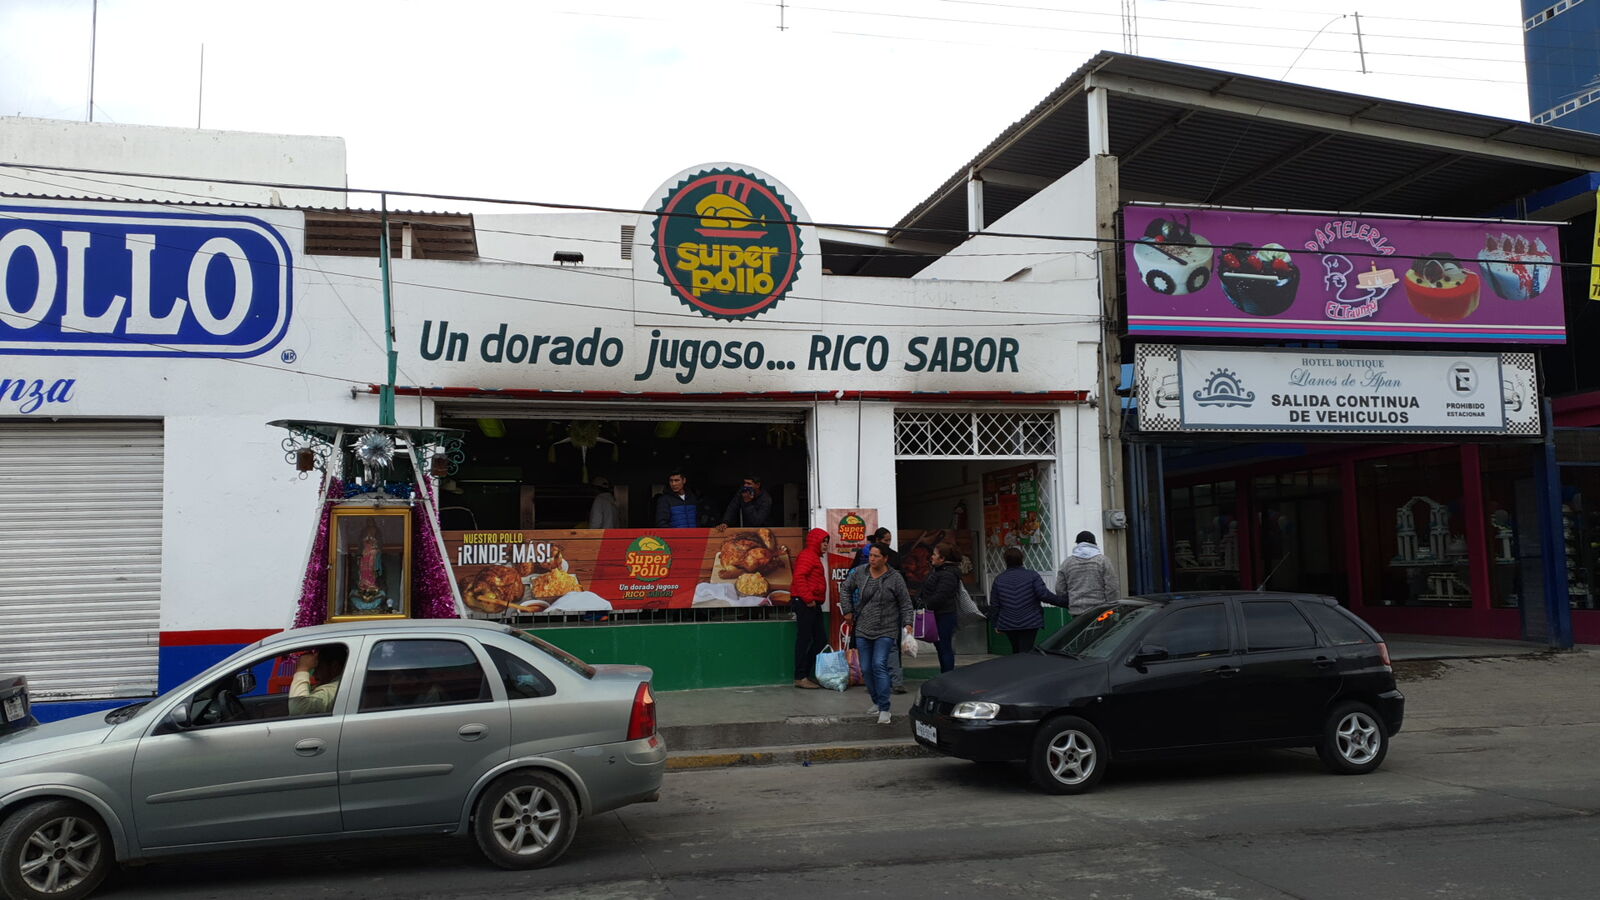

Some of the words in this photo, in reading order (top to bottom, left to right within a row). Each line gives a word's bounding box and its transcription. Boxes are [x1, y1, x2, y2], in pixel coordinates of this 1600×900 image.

[1304, 220, 1396, 256] PASTELERIA
[420, 320, 469, 362] Un
[480, 323, 624, 367] dorado
[634, 329, 796, 385] jugoso...
[808, 334, 889, 372] RICO
[904, 336, 1020, 373] SABOR
[1301, 358, 1334, 367] HOTEL
[1336, 359, 1385, 369] BOUTIQUE
[1288, 367, 1338, 388] Llanos
[1341, 373, 1356, 388] de
[1360, 368, 1402, 394] Apan
[1271, 394, 1331, 407] SALIDA
[1336, 395, 1420, 409] CONTINUA
[1446, 402, 1485, 410] PROHIBIDO
[1289, 410, 1311, 423] DE
[1316, 411, 1409, 424] VEHICULOS
[839, 525, 865, 535] Super
[842, 532, 865, 540] Pollo
[463, 533, 498, 544] NUESTRO
[500, 533, 523, 543] POLLO
[458, 543, 508, 566] ¡RINDE
[512, 541, 551, 563] MÁS!
[626, 552, 670, 567] Super
[630, 564, 668, 577] Pollo
